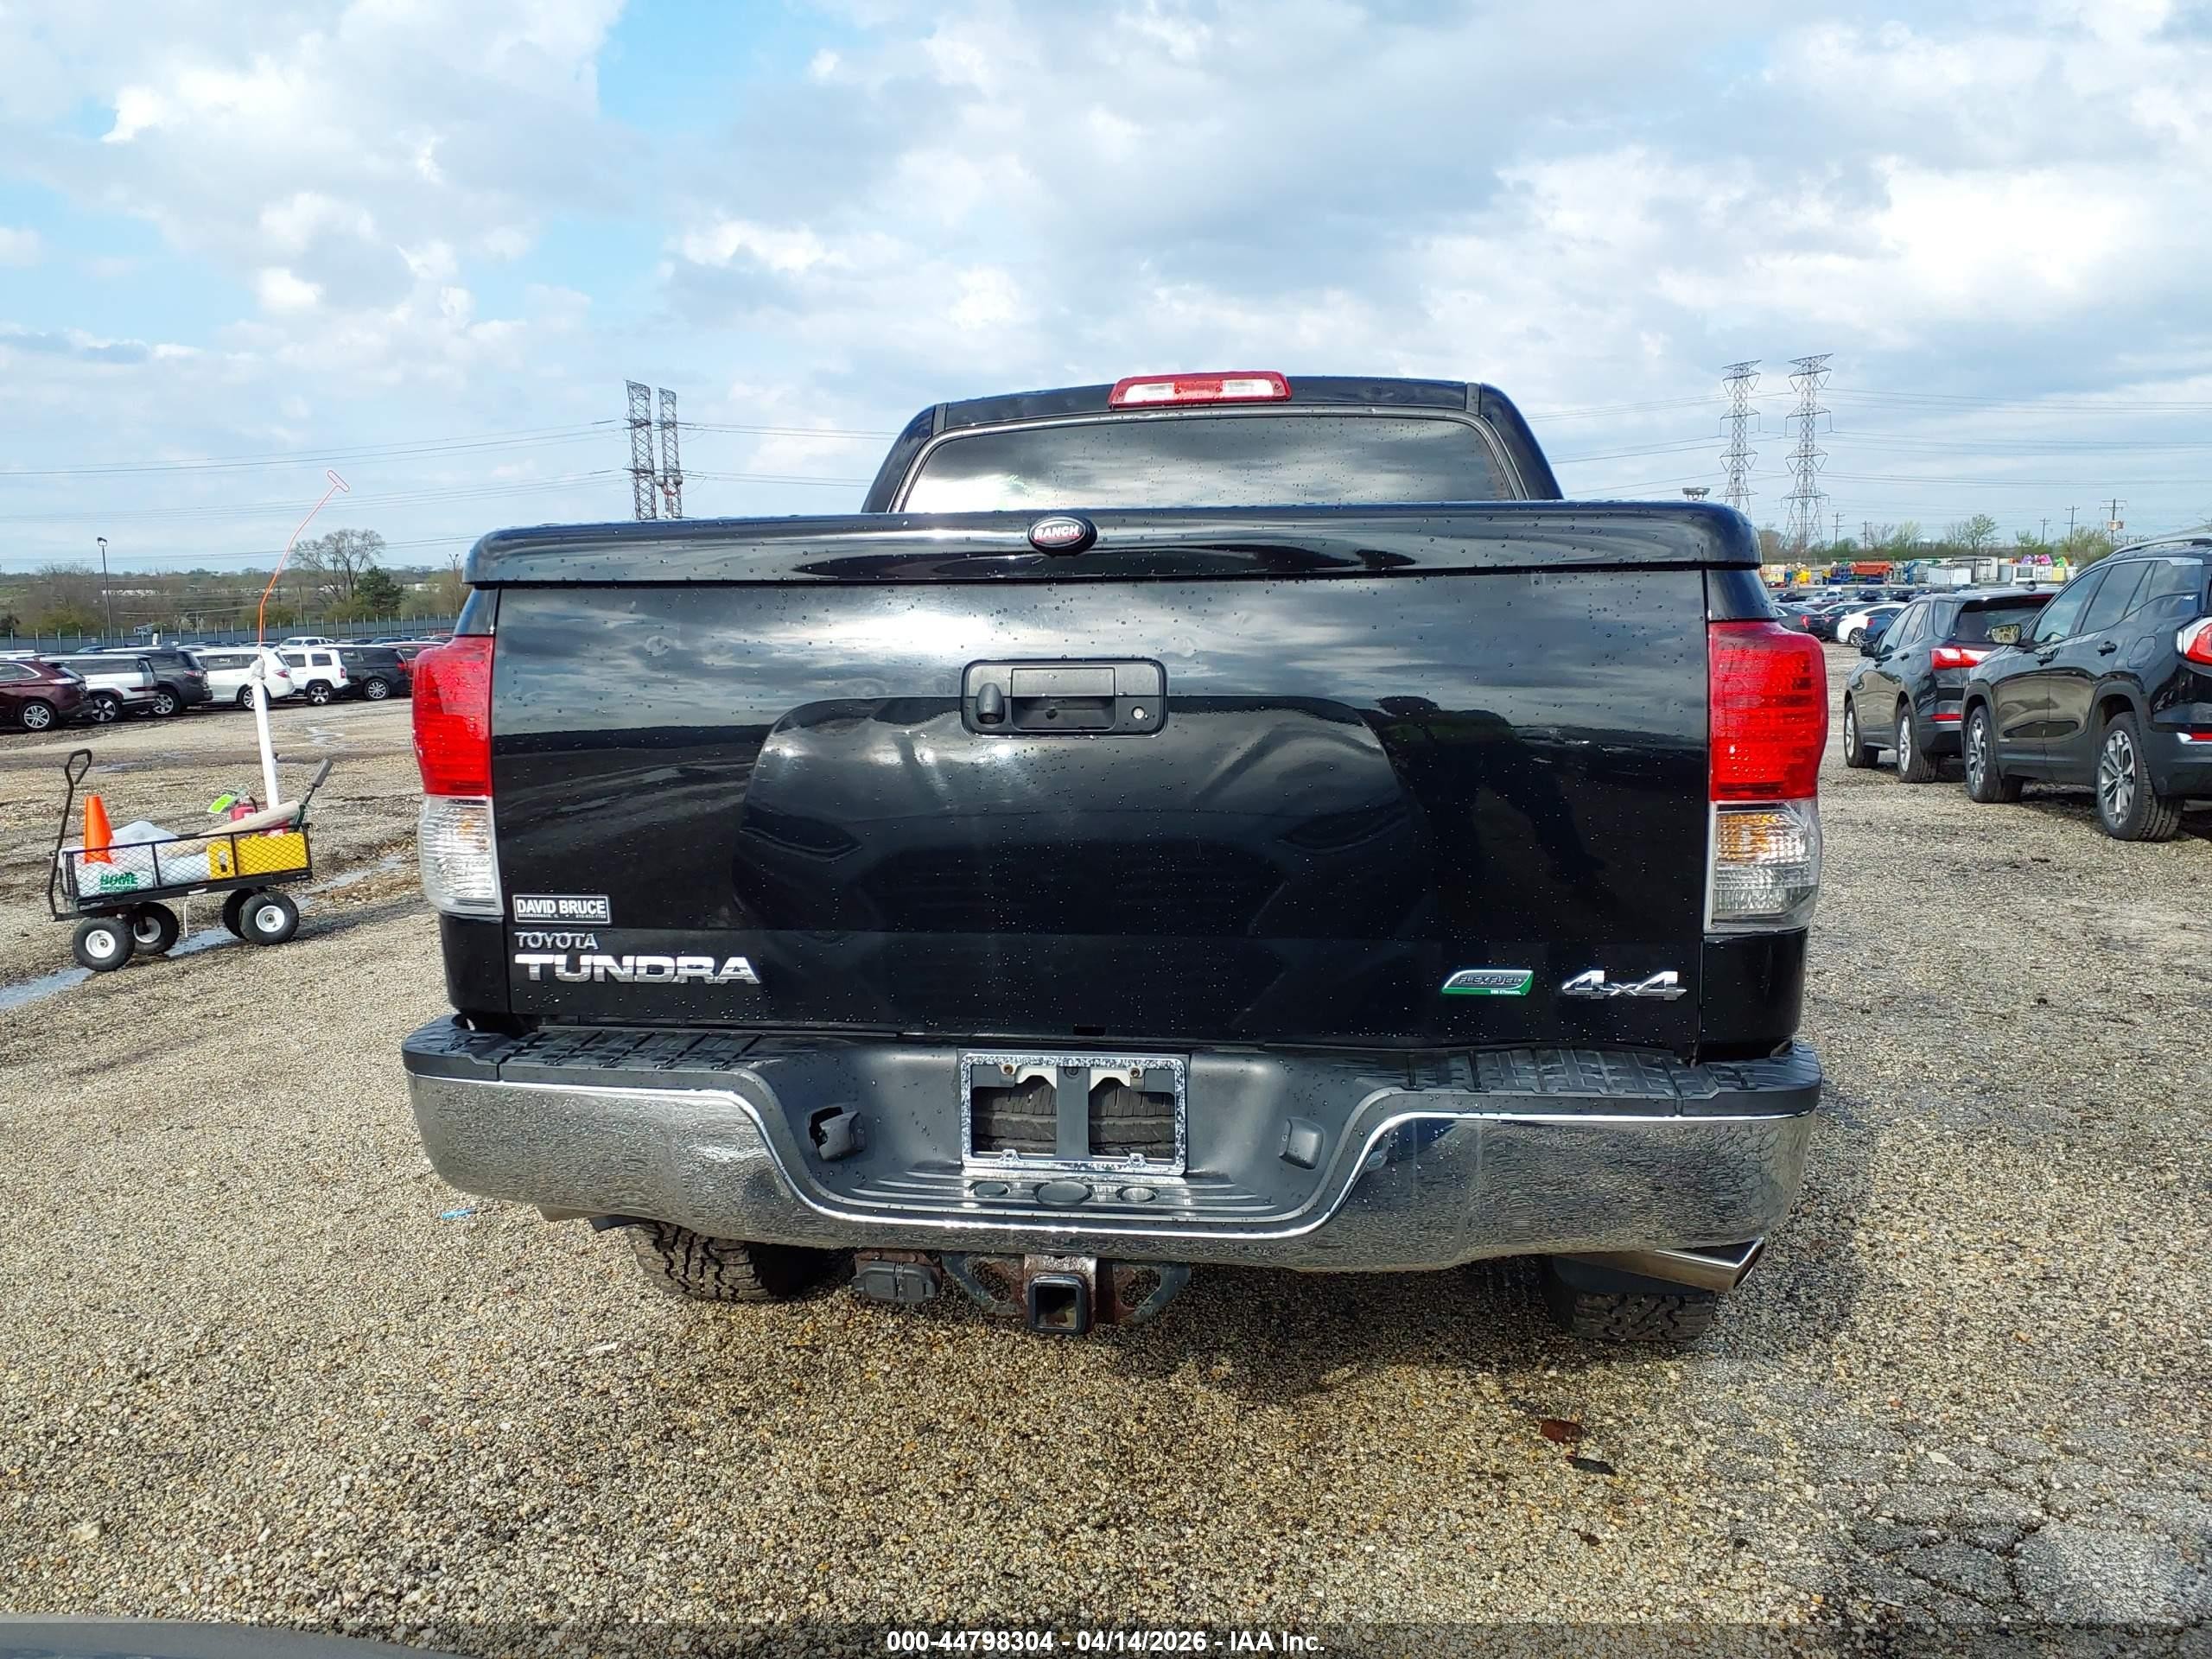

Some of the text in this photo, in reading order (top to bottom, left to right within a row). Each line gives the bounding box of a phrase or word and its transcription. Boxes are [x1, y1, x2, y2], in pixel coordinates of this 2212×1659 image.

[1034, 525, 1080, 540] RANCH
[517, 899, 607, 915] DAVID BRUCE
[514, 932, 599, 950] TOYOTA
[515, 954, 760, 984] TUNDRA
